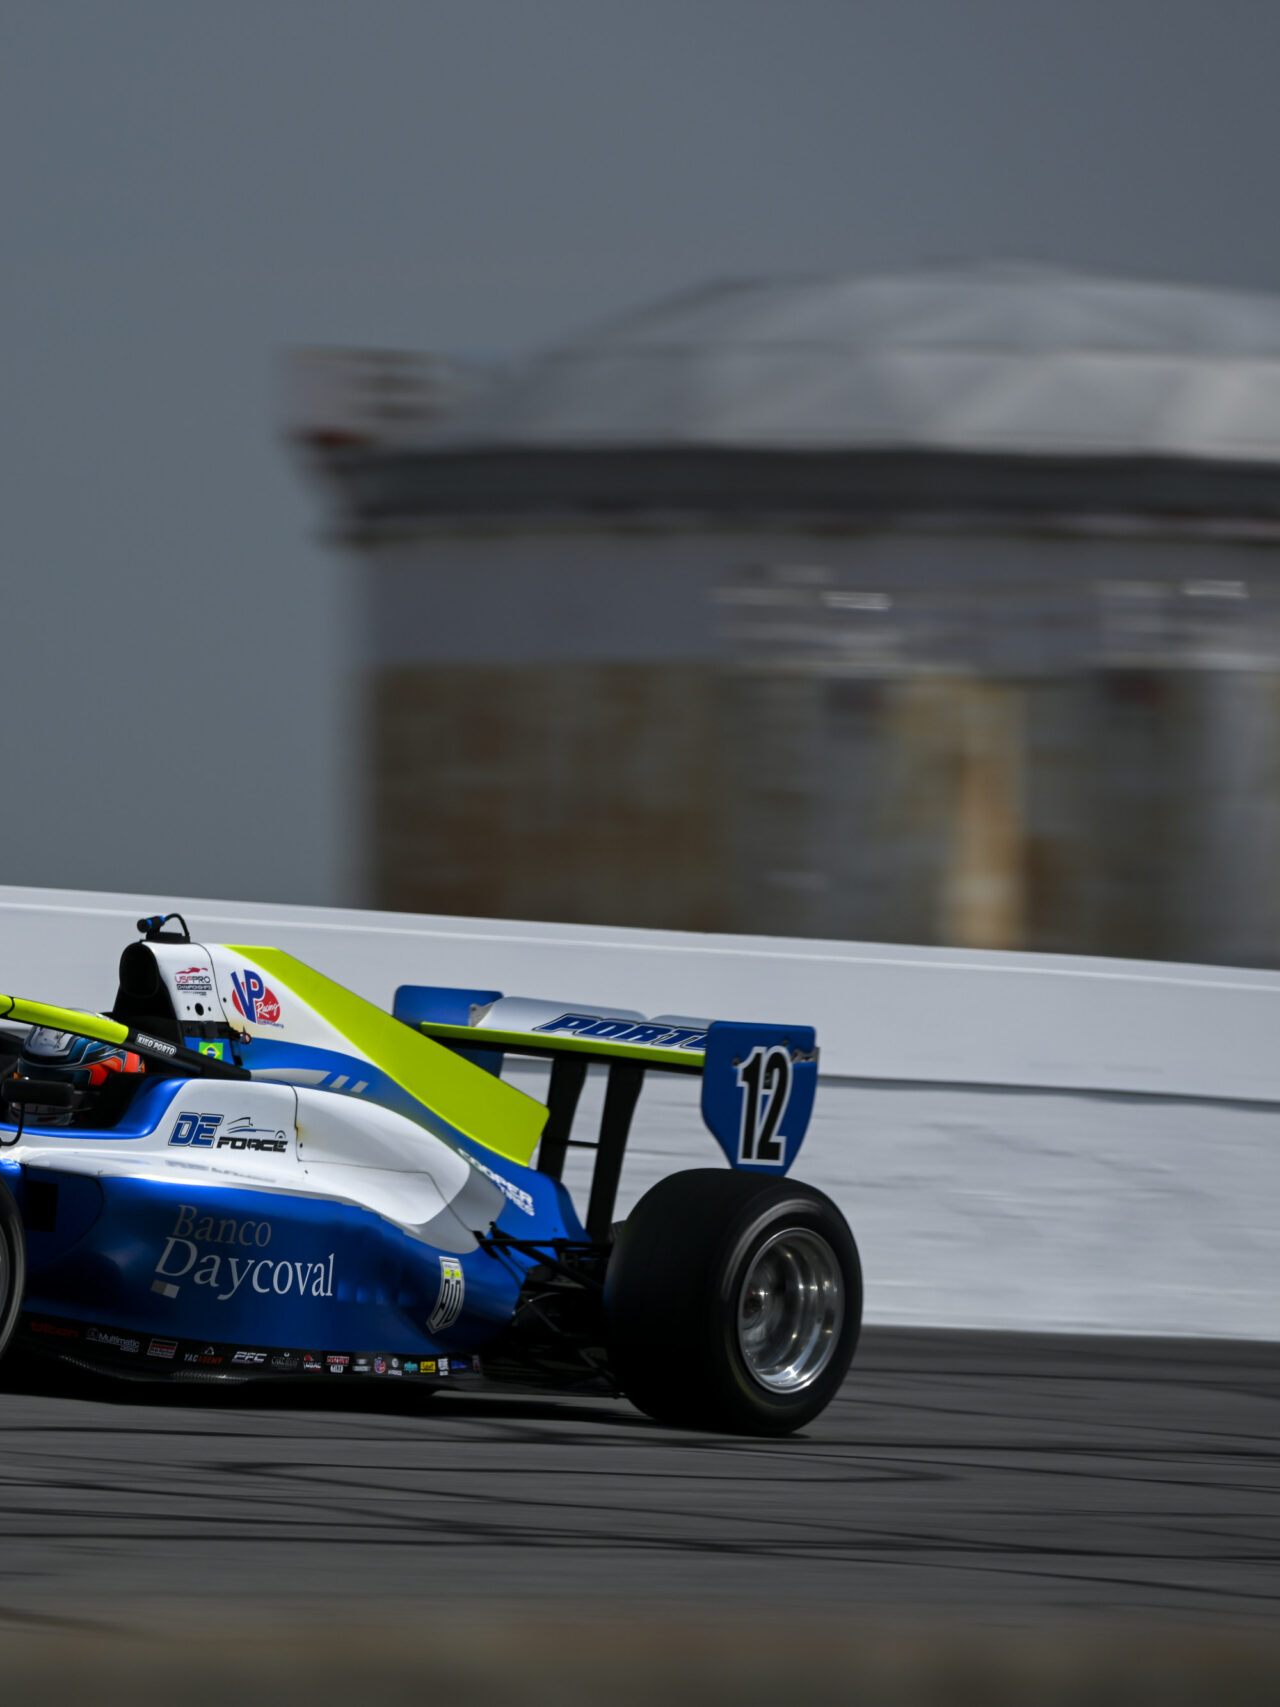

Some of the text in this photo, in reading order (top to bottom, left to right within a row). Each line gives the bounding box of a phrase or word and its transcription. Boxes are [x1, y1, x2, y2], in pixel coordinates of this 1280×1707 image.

[230, 969, 265, 1023] VP
[153, 1041, 176, 1056] PORTO
[737, 1045, 793, 1166] 12
[168, 1111, 224, 1148] DE
[216, 1136, 288, 1152] FORCE
[457, 1147, 534, 1203] COOPER
[172, 1204, 272, 1247] Banco
[154, 1236, 335, 1300] Daycoval
[97, 1332, 140, 1348] Multimatic
[234, 1351, 268, 1363] PFC
